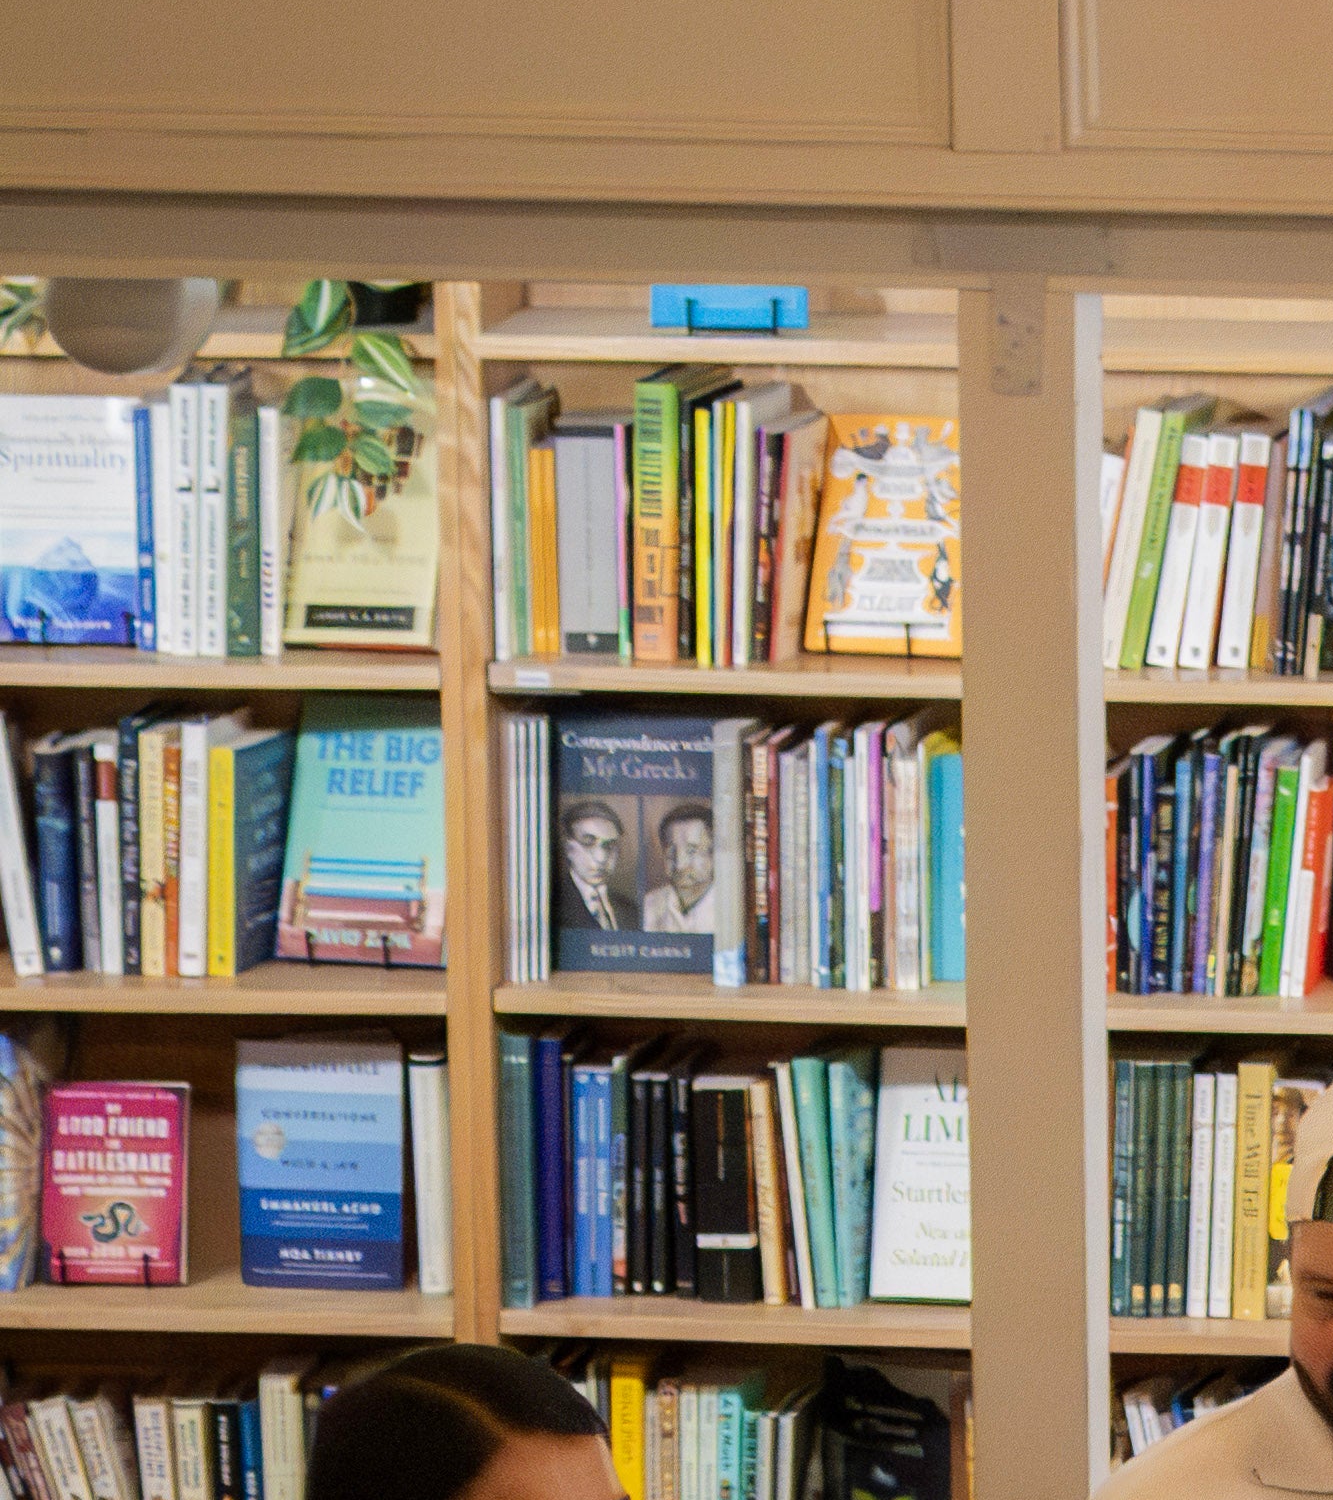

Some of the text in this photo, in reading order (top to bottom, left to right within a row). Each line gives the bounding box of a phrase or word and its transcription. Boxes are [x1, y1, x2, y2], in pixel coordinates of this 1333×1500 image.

[315, 730, 442, 765] THE BIG
[327, 767, 426, 797] RELIEF
[621, 756, 697, 780] Greeks
[58, 1116, 170, 1139] GOOD FRIEND
[902, 1113, 963, 1143] LIM
[1243, 1144, 1262, 1179] Will
[259, 1197, 383, 1216] EMMANUEL ACHO
[1243, 1188, 1260, 1219] Tell
